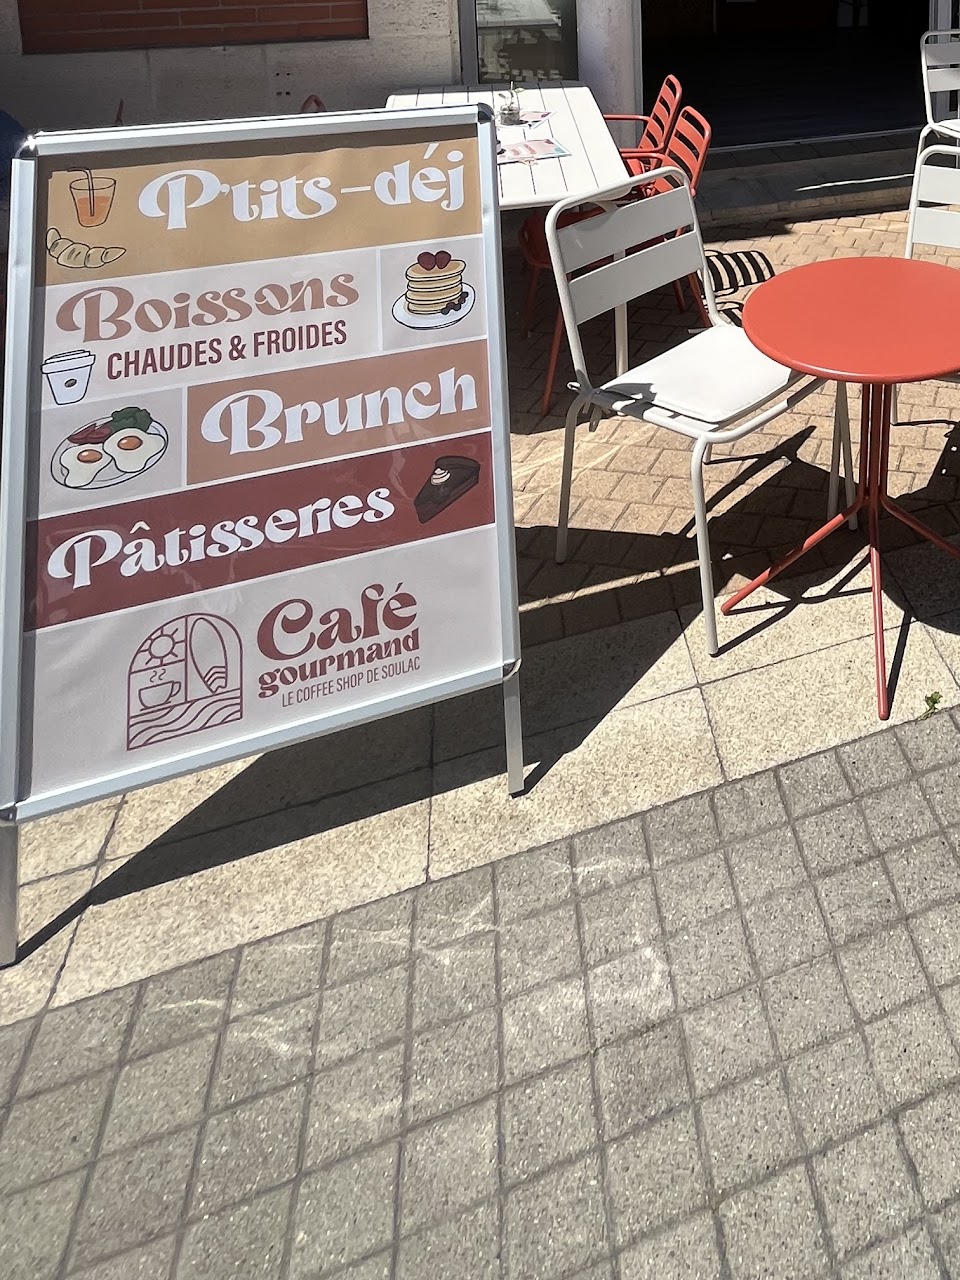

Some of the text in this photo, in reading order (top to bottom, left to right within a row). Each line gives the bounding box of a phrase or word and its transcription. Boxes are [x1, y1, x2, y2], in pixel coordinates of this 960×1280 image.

[138, 142, 466, 231] P'tits-déj
[55, 272, 360, 343] Boissons
[107, 319, 347, 380] CHAUDES & FROIDES
[201, 366, 478, 455] Brunch
[47, 487, 396, 590] Pâtisseries
[257, 581, 419, 662] Café
[257, 627, 421, 699] gourmand
[281, 656, 421, 708] LE COFFEE SHOP DE SOULAC
